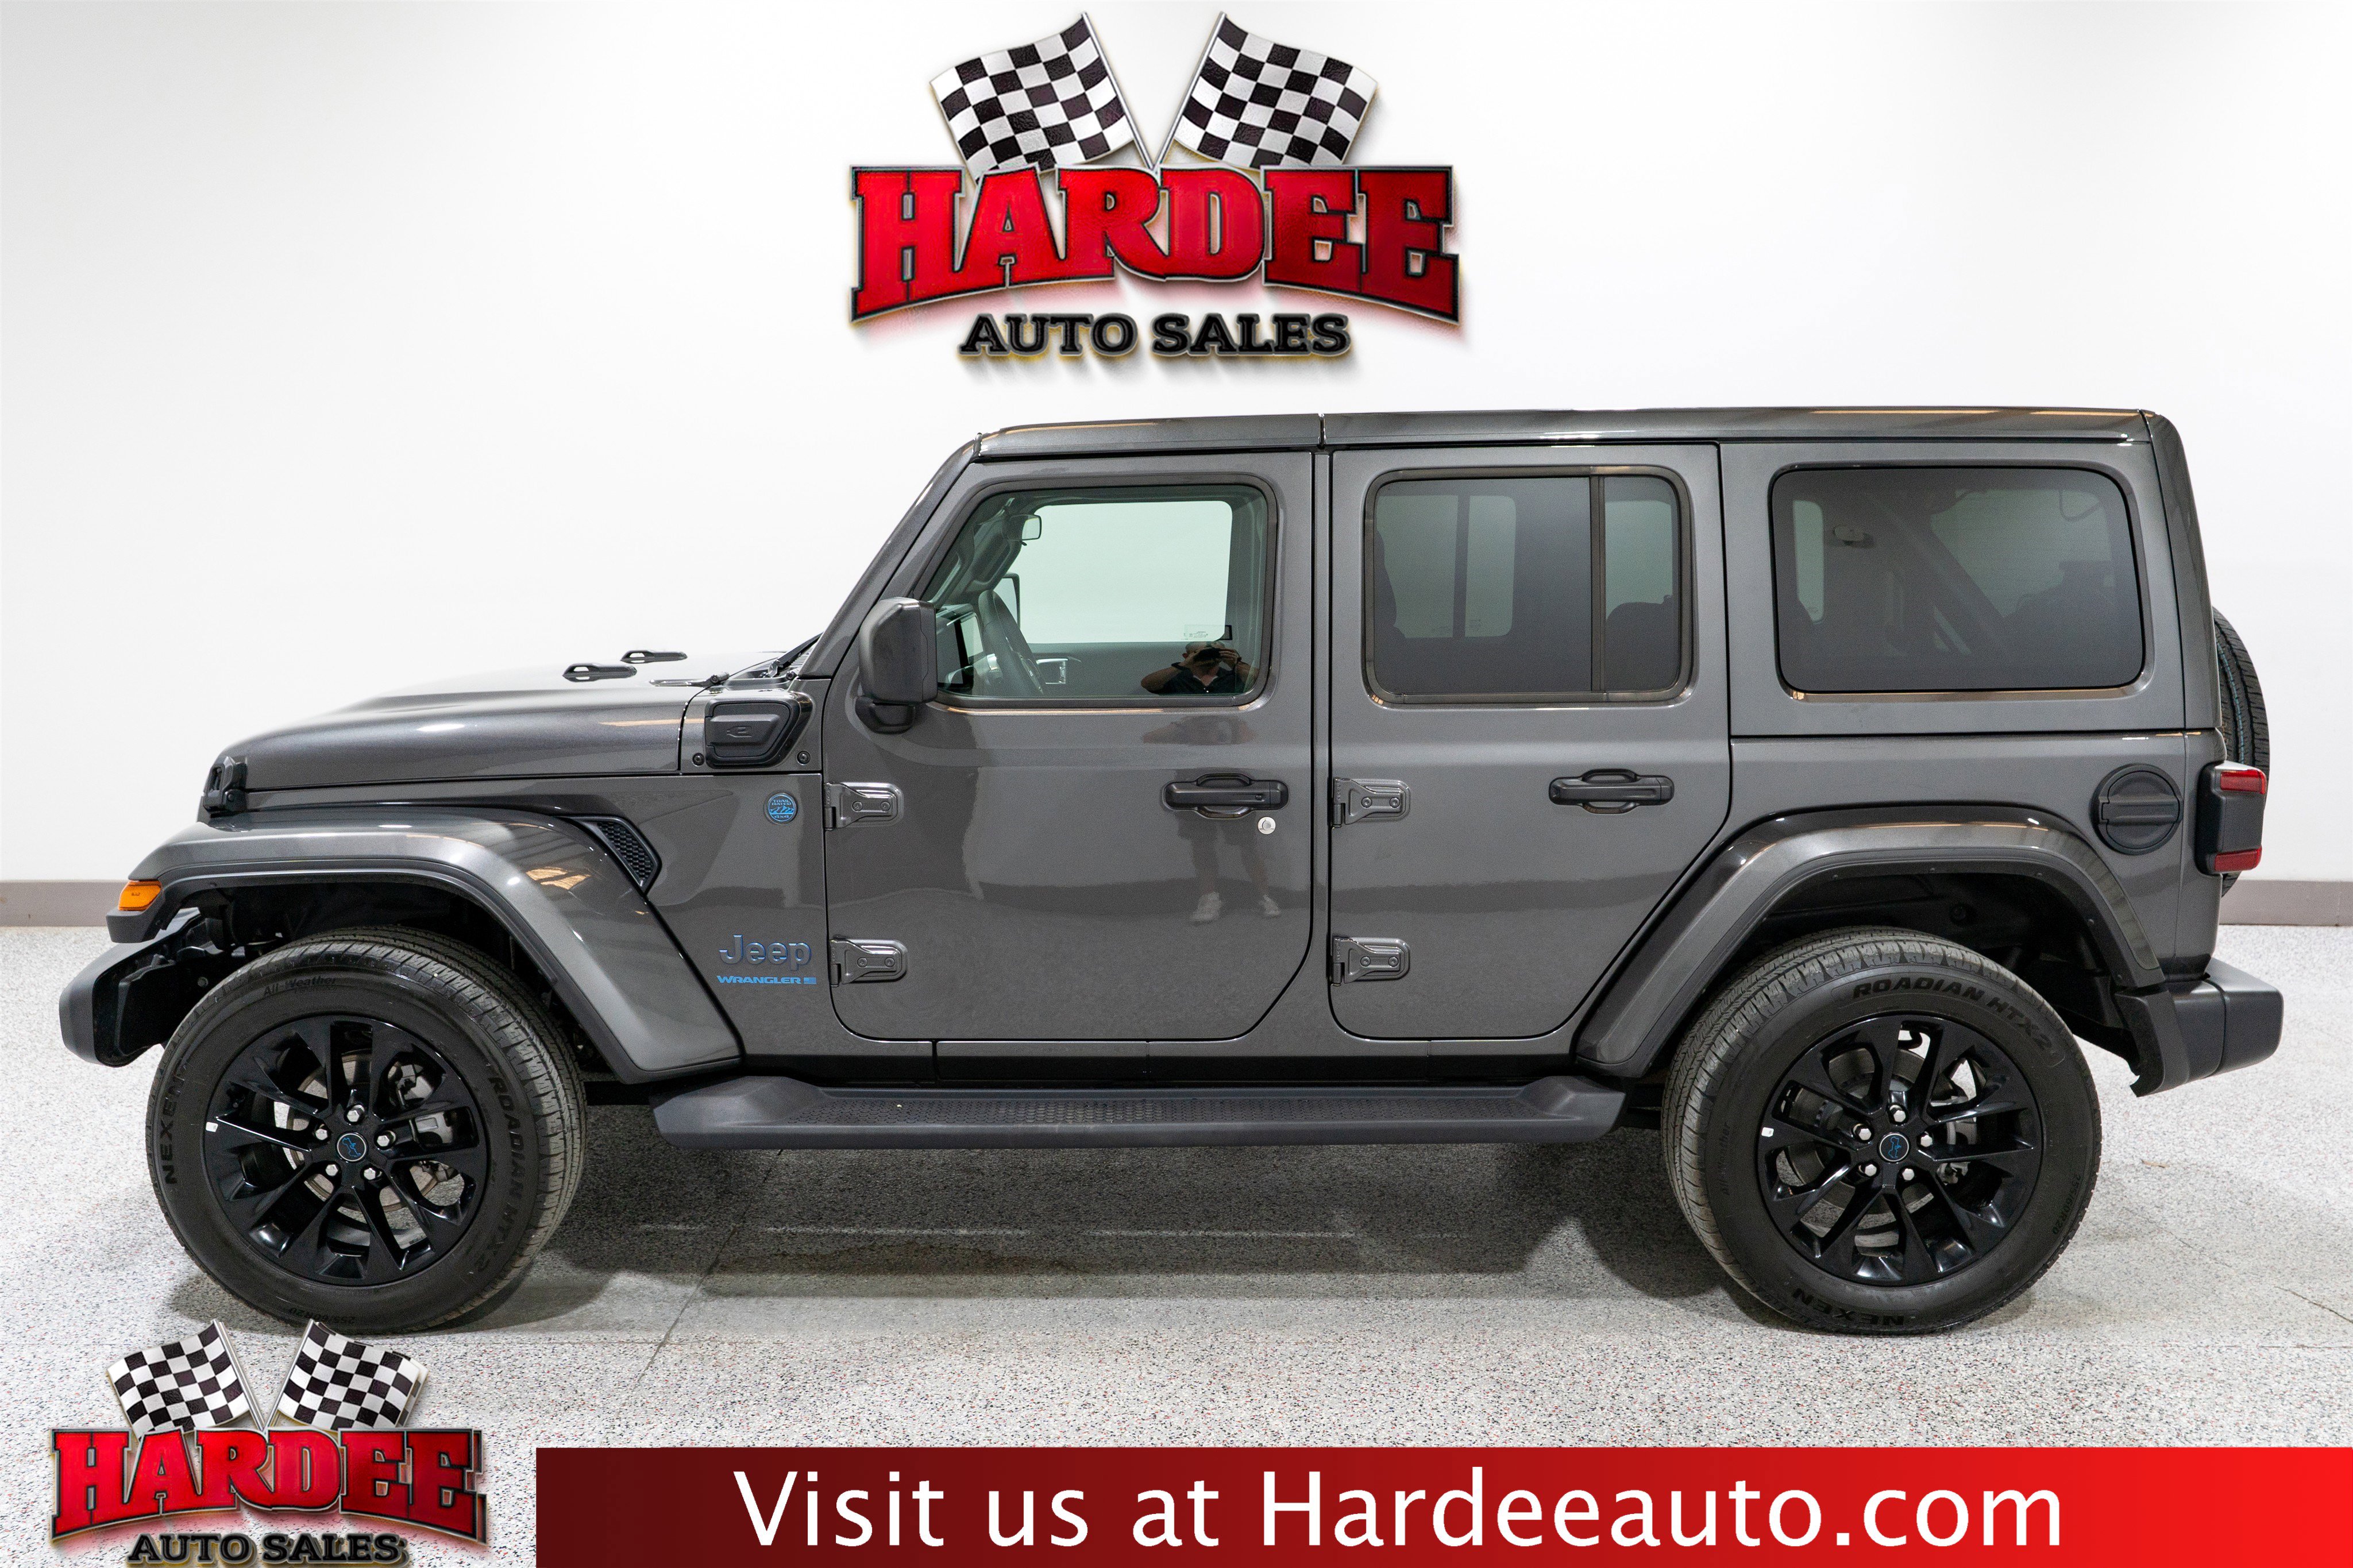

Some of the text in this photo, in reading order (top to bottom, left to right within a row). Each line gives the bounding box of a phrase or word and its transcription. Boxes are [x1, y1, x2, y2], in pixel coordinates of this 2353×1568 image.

[719, 934, 812, 971] Jeep
[716, 975, 801, 984] WRANGLER
[1852, 977, 1985, 1001] ROADIAN
[160, 1075, 185, 1185] NEXEN
[1792, 1287, 1905, 1326] NEXEN
